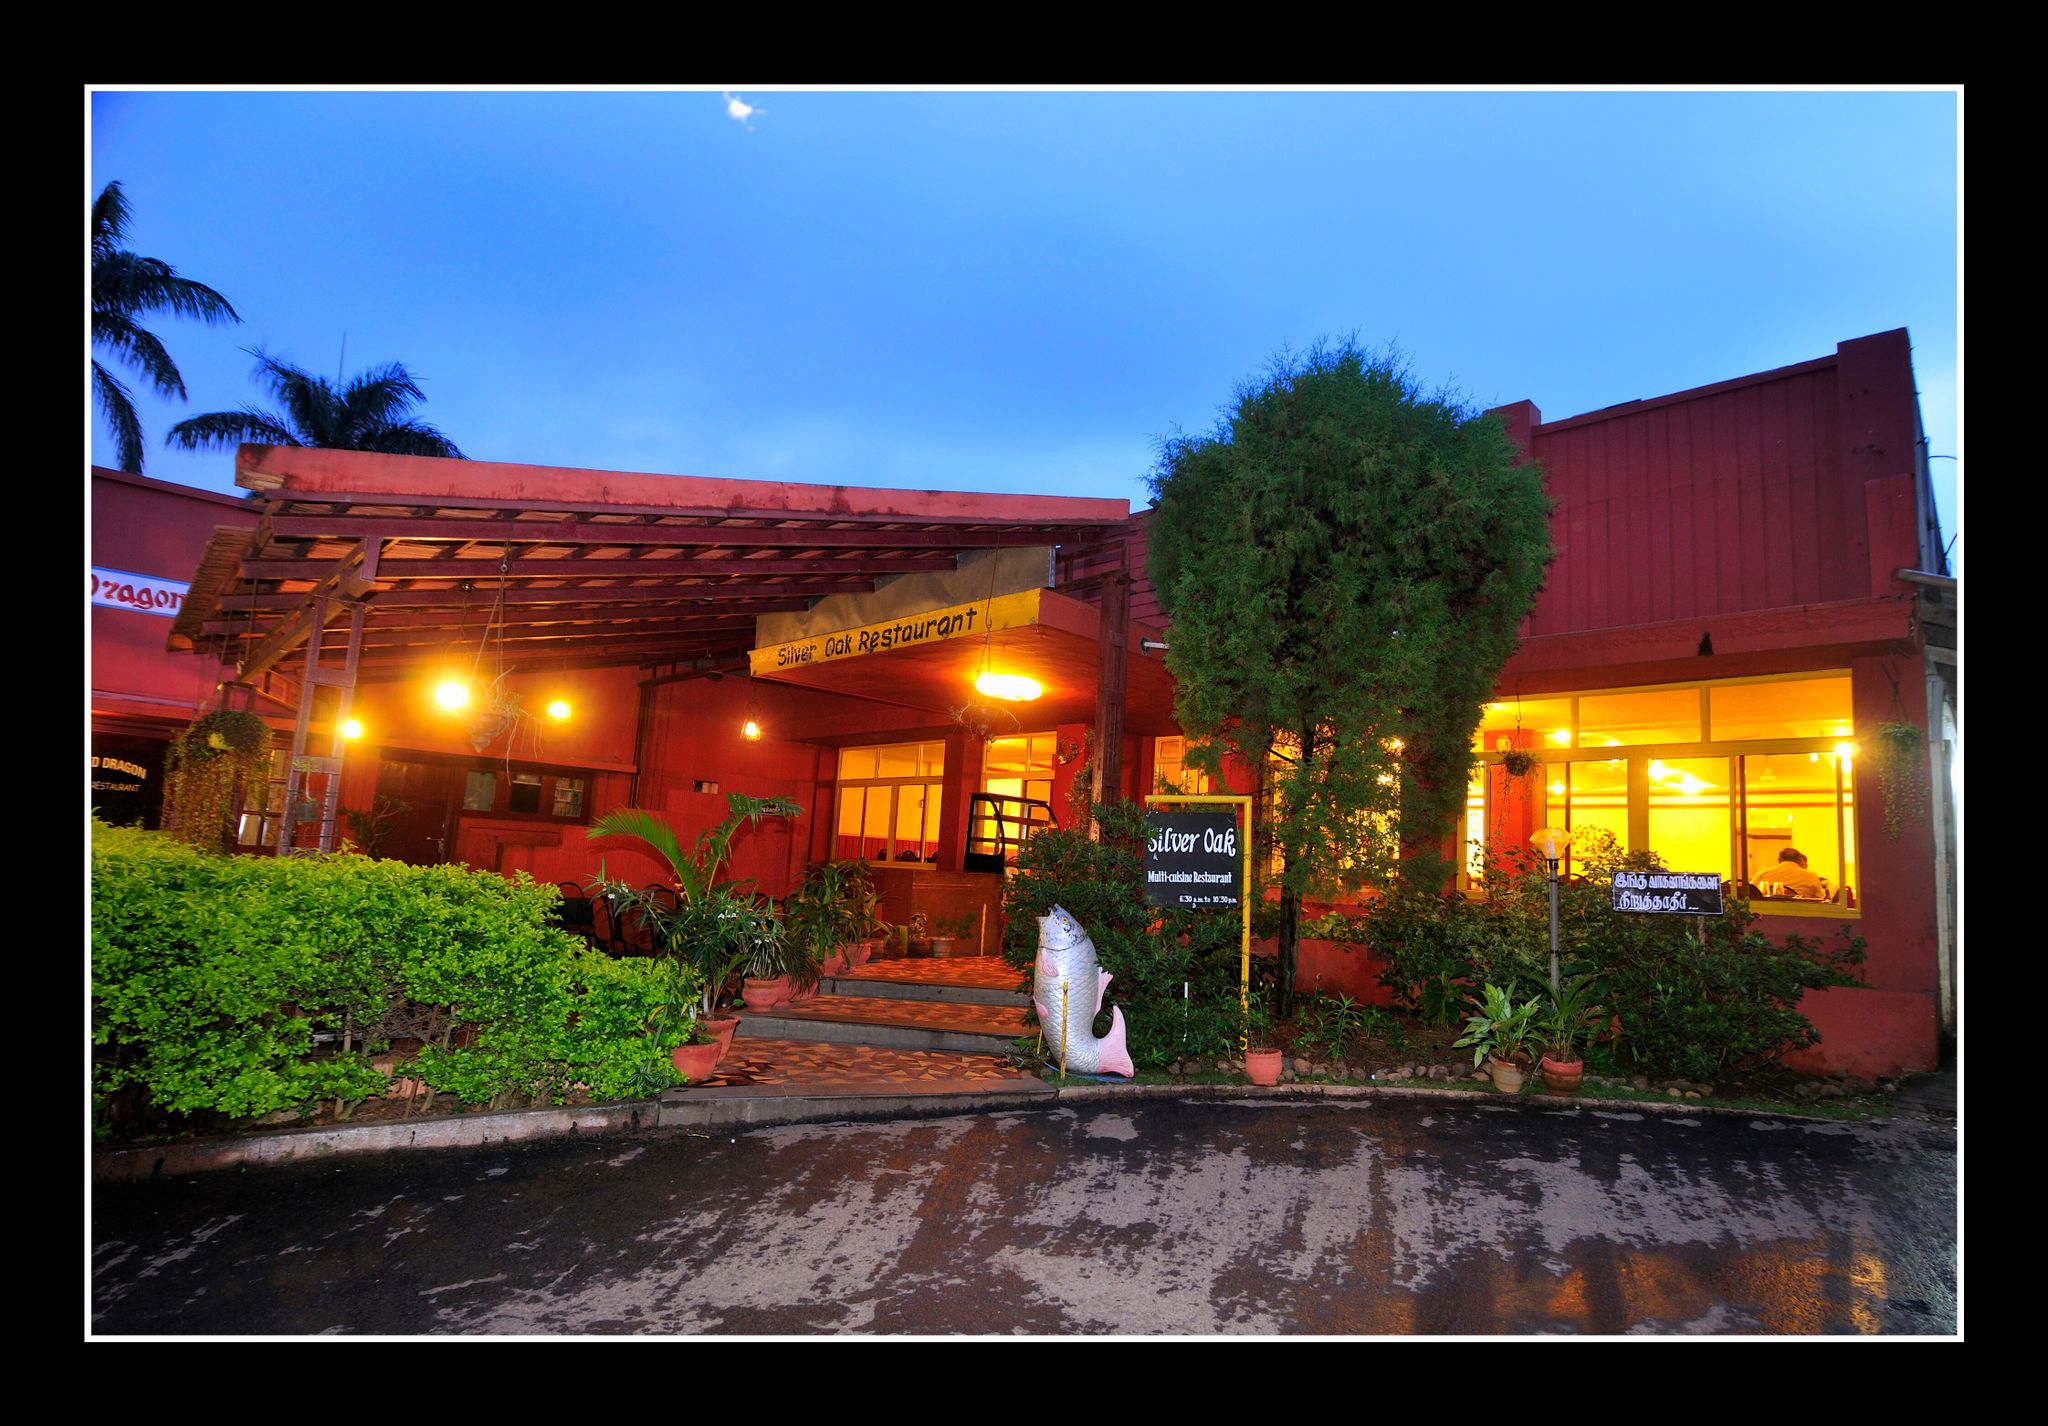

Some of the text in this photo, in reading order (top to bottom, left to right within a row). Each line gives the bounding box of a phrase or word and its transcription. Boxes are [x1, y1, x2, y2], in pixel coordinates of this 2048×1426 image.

[778, 607, 977, 666] Silver Oak Restaurant
[102, 757, 147, 780] DRAGON
[1148, 827, 1236, 857] Silver Oak
[1148, 870, 1233, 884] Multi-cuisine Restaurant
